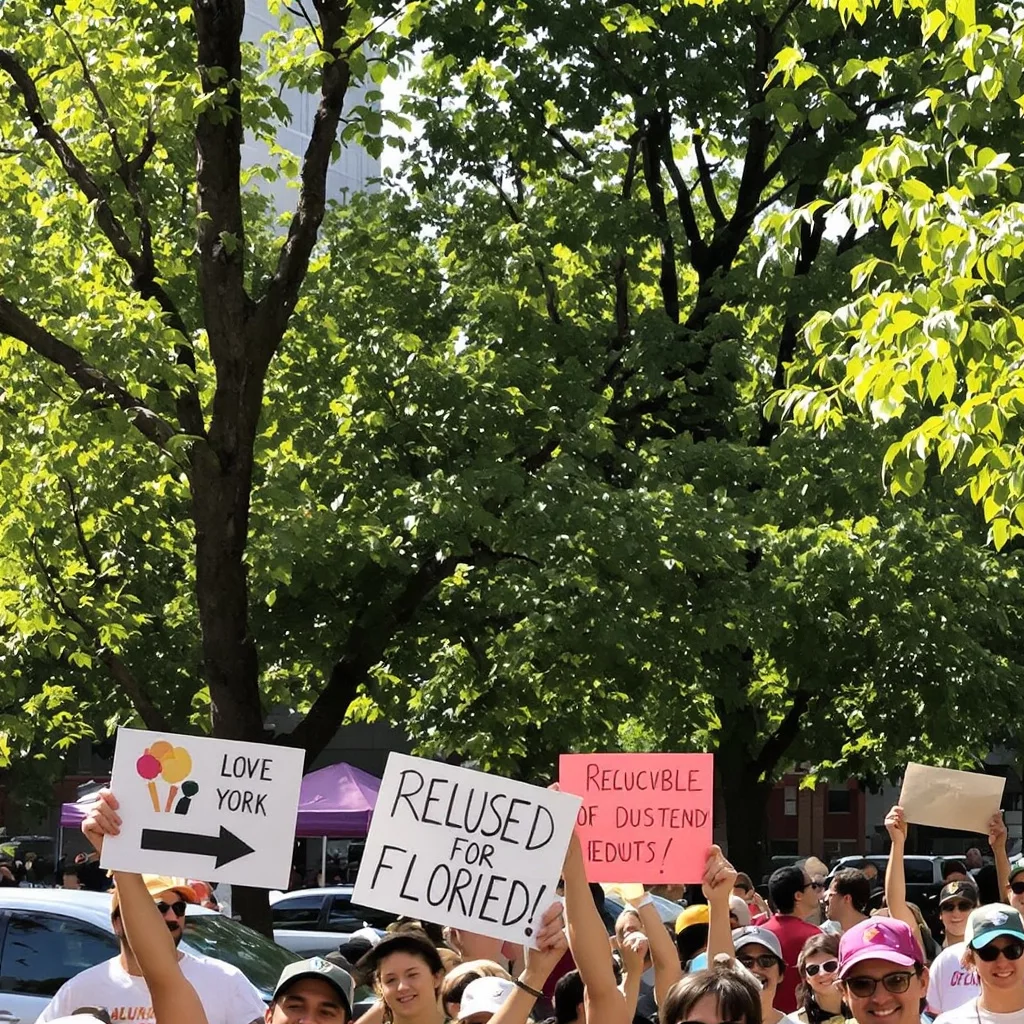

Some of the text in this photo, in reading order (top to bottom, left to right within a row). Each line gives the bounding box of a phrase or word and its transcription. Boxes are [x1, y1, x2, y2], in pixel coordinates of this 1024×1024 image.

[220, 753, 273, 782] LOVE
[216, 788, 268, 817] YORK
[390, 769, 555, 851] RELUSED
[577, 805, 599, 827] OF
[450, 837, 494, 869] FOR
[370, 845, 547, 938] FLORIED!
